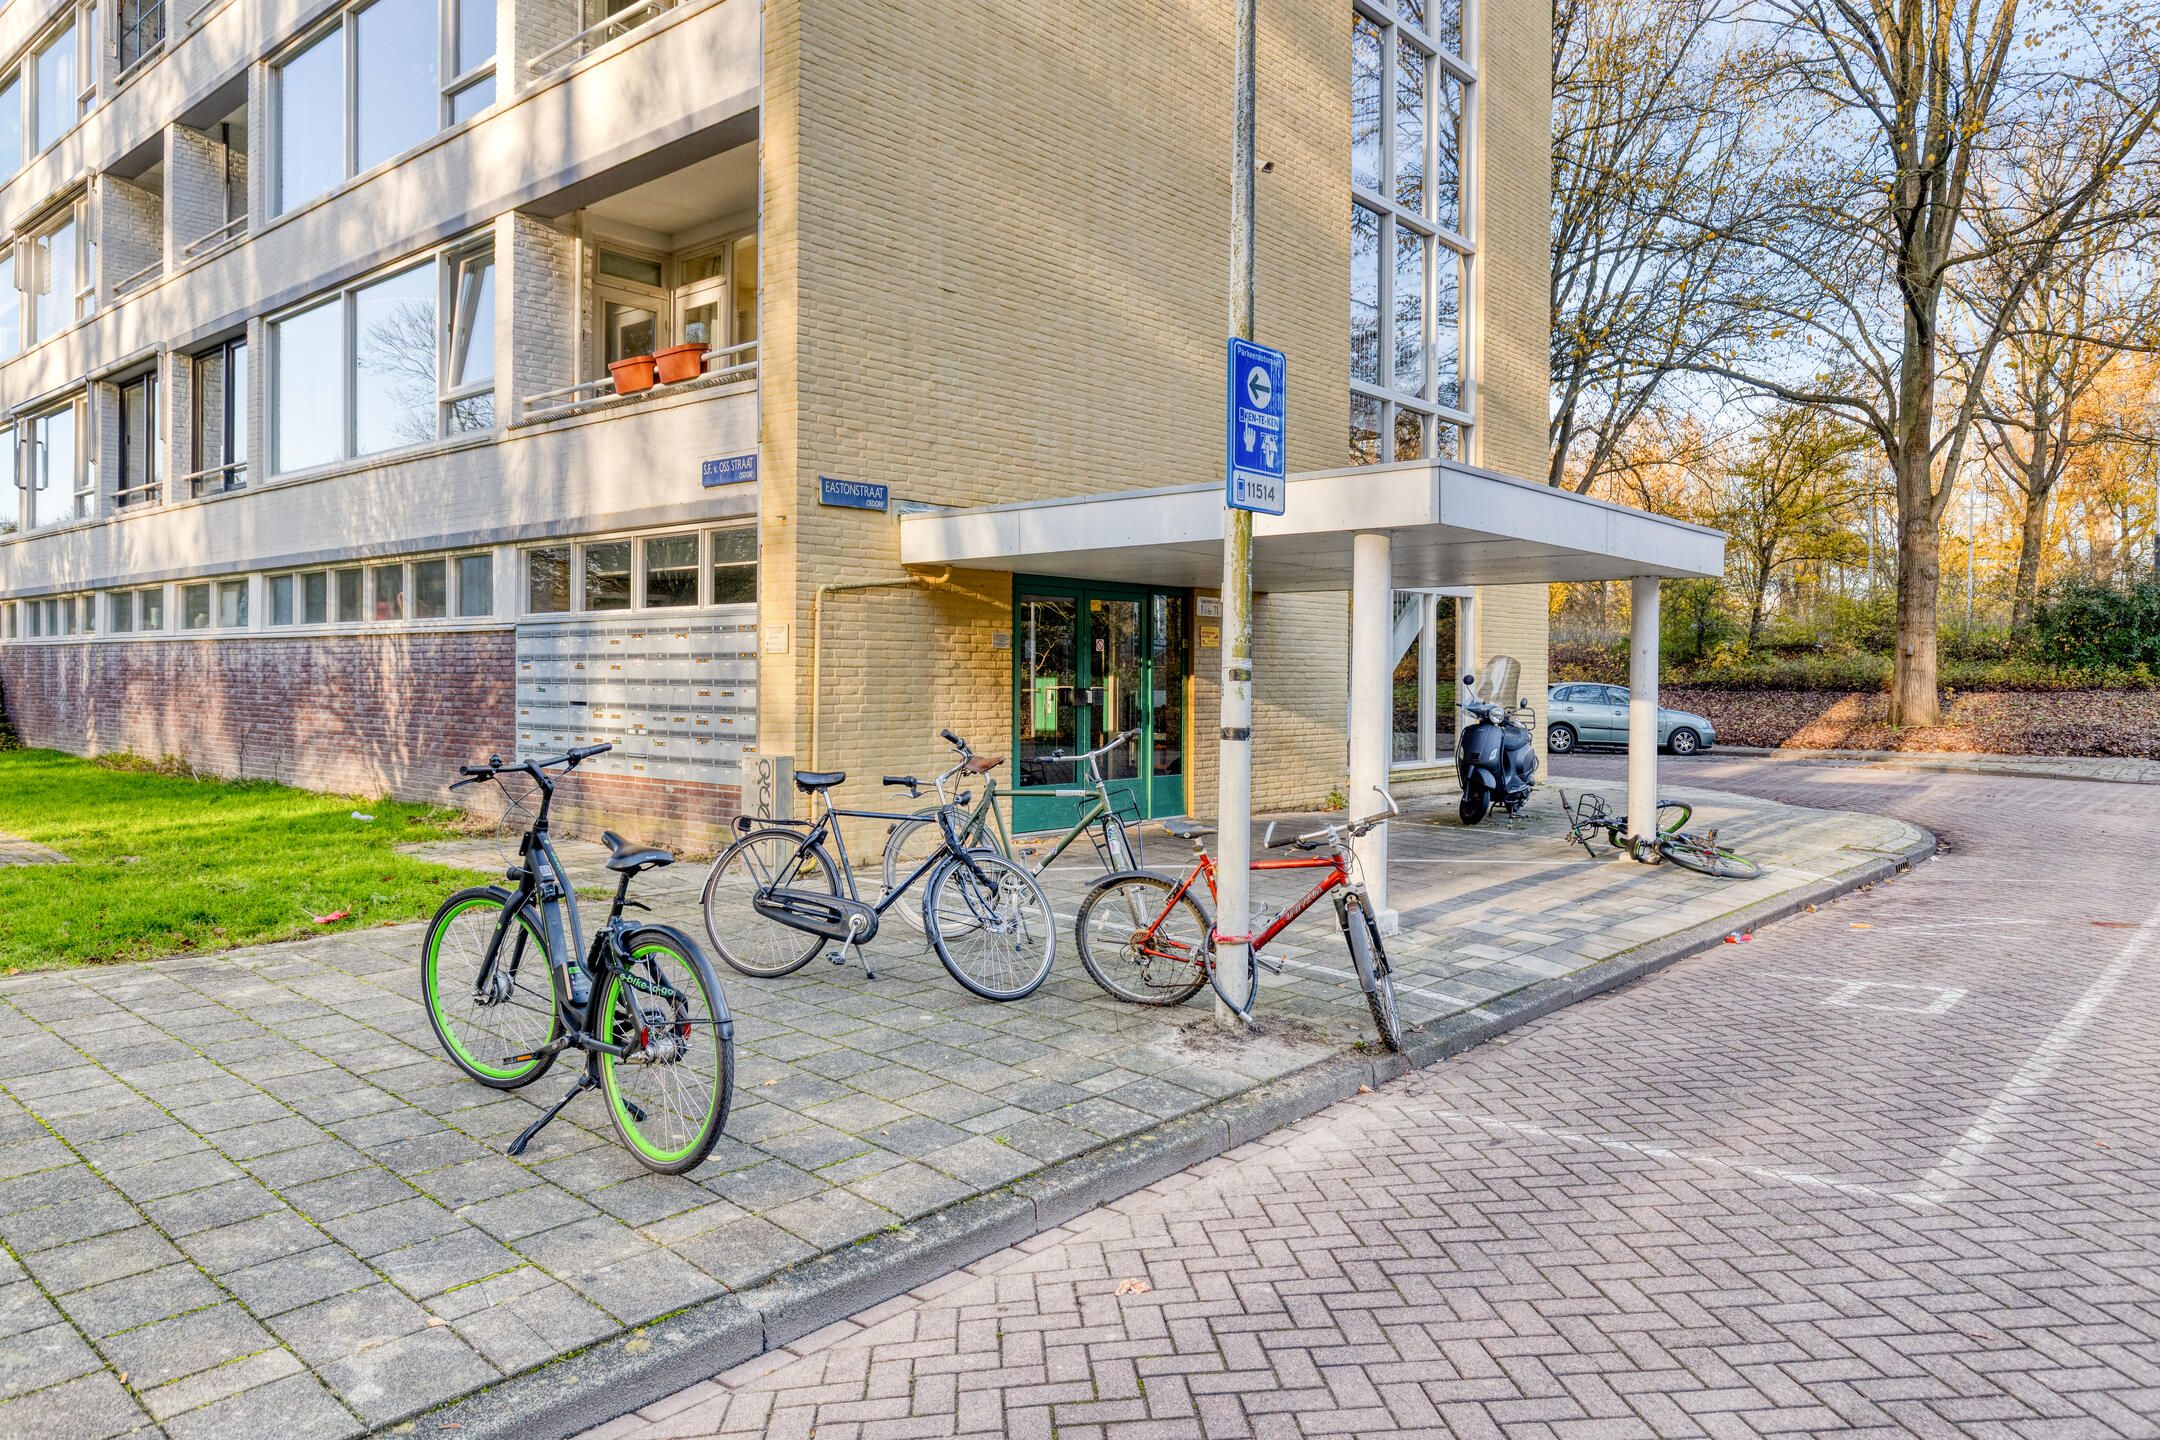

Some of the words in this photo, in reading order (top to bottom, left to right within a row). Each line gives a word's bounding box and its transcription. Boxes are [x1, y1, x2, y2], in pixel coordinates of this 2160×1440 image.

[1237, 346, 1282, 368] Parkeerautomaat
[703, 462, 713, 475] S.F.
[719, 460, 730, 473] OSS
[731, 457, 754, 471] STRAAT
[738, 470, 754, 479] OSDORP
[825, 480, 884, 499] EASTONSTRAAT
[1247, 481, 1276, 503] 11514
[866, 498, 885, 508] OSDORP
